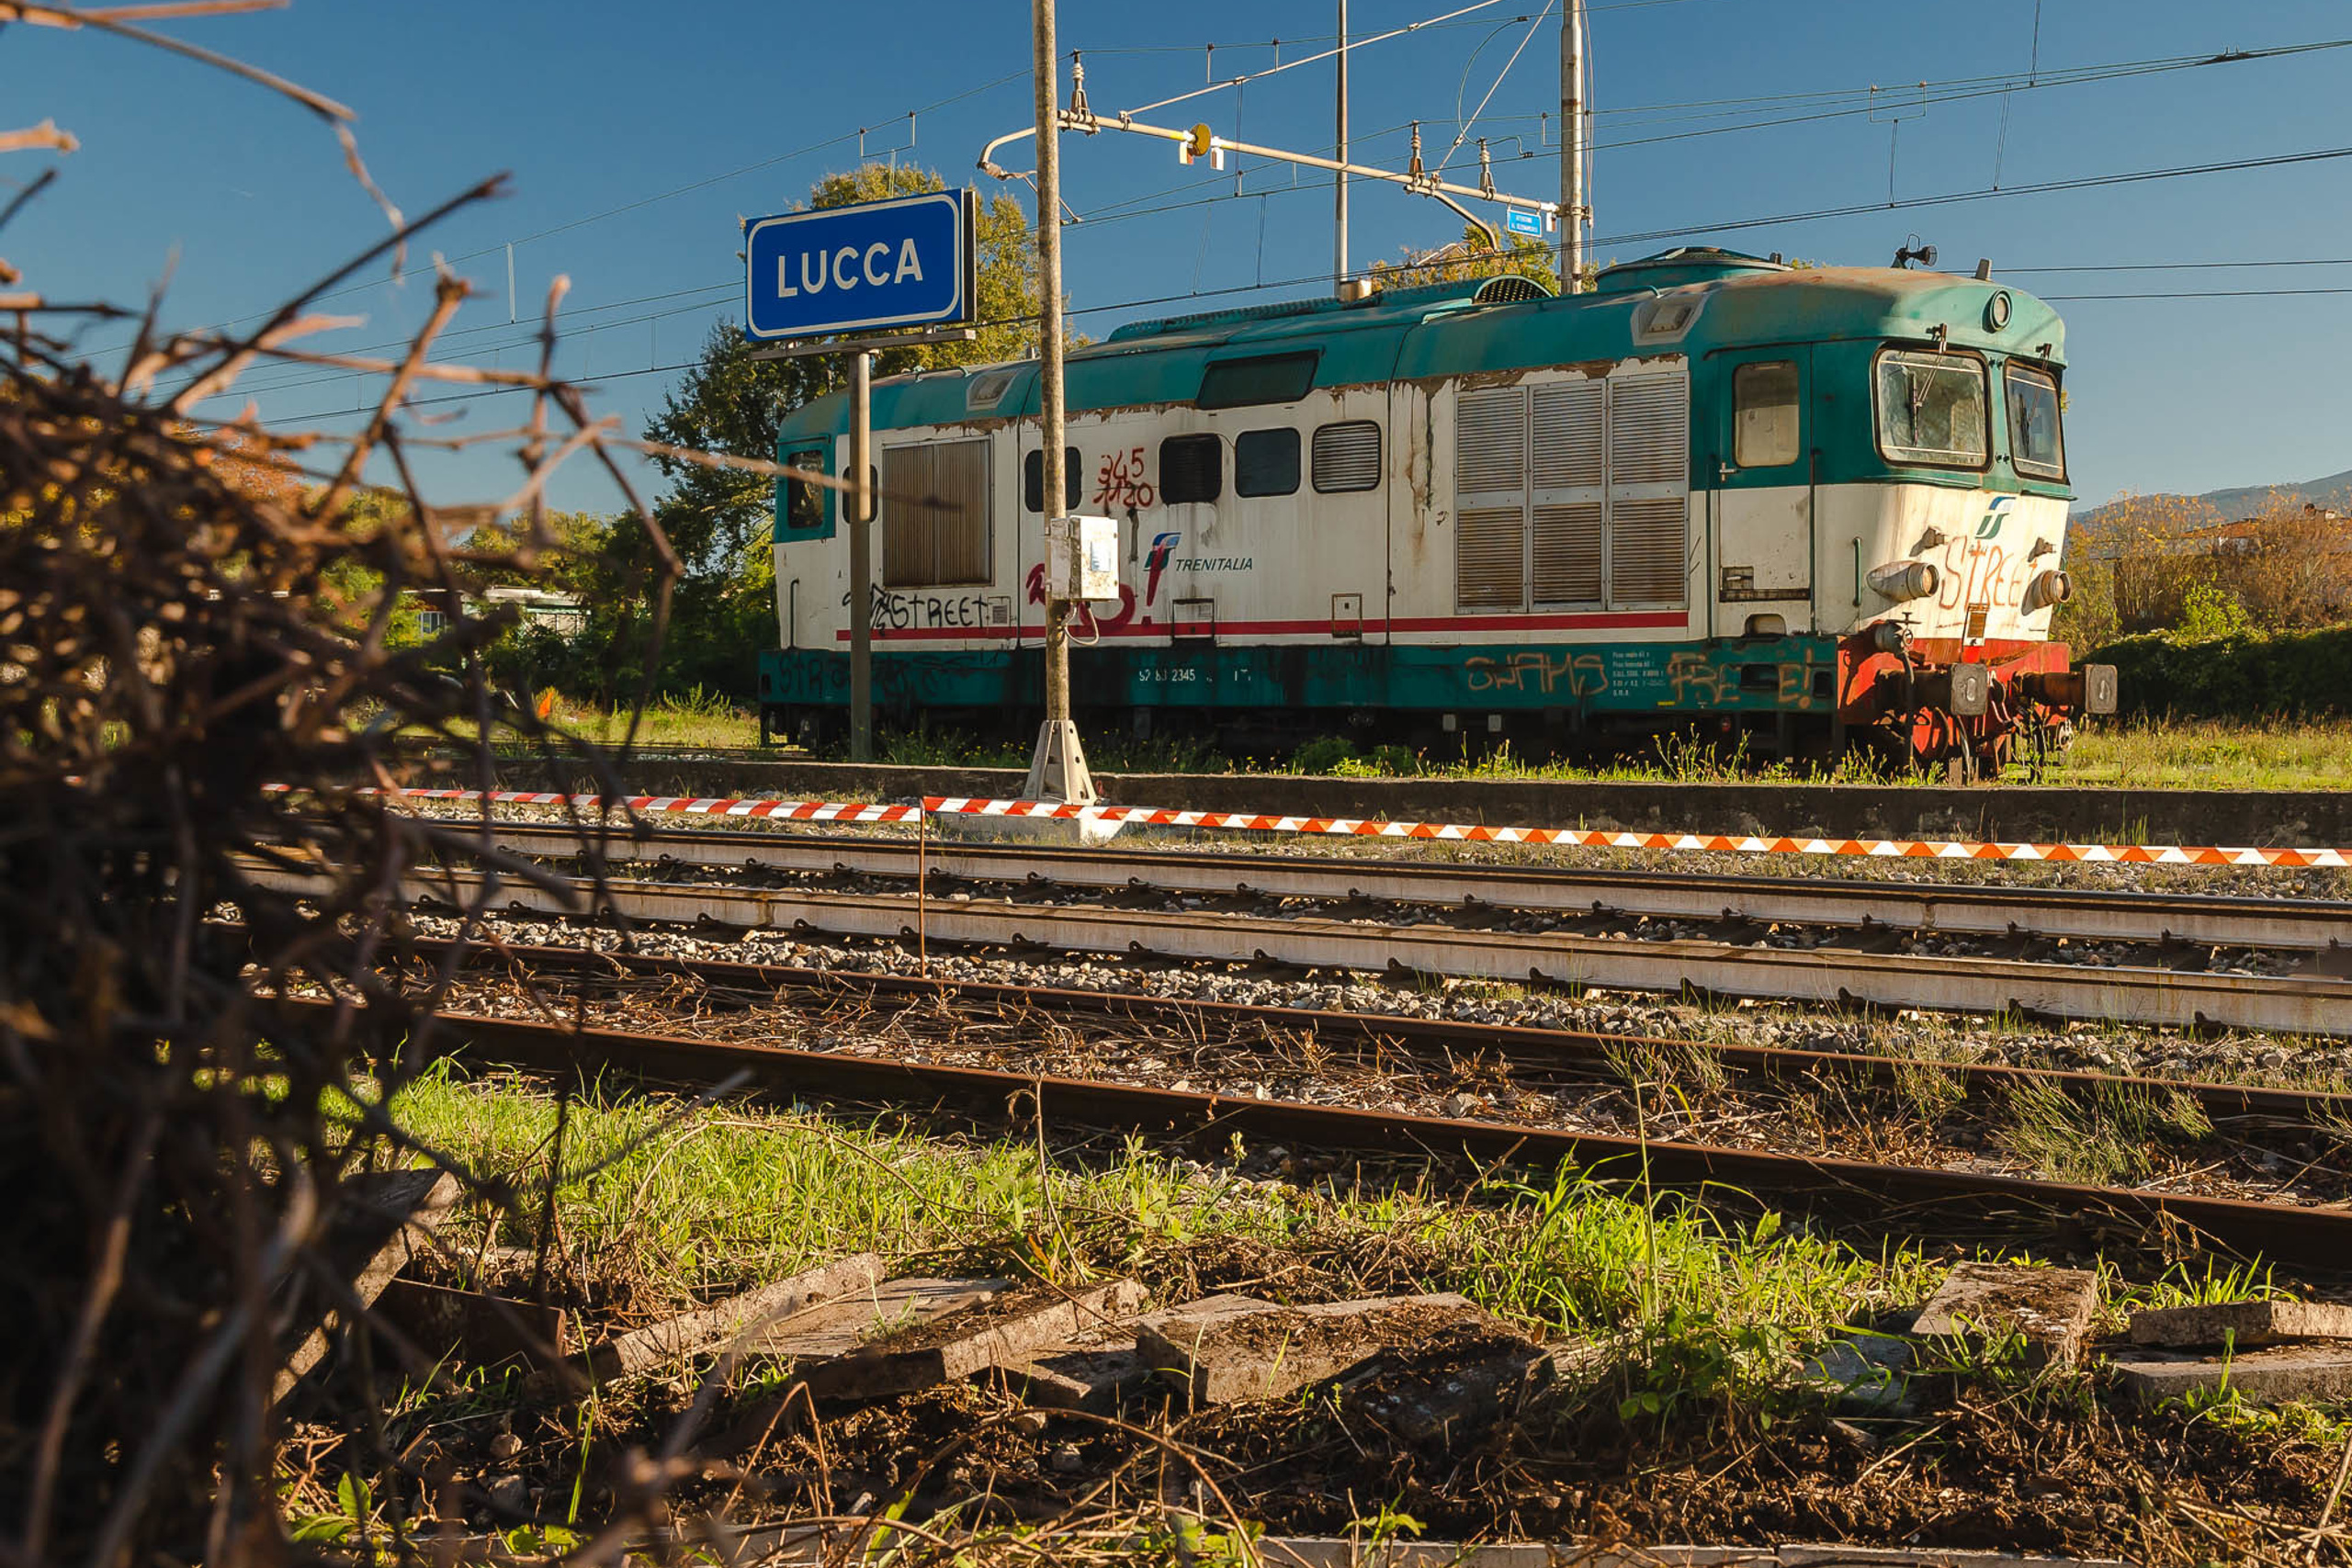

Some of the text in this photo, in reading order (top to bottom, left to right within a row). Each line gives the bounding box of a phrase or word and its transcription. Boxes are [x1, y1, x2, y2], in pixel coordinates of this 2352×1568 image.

[778, 238, 923, 299] LUCCA
[1097, 446, 1145, 485] 345
[1176, 558, 1253, 572] TRENITALIA
[1171, 669, 1196, 682] 2345
